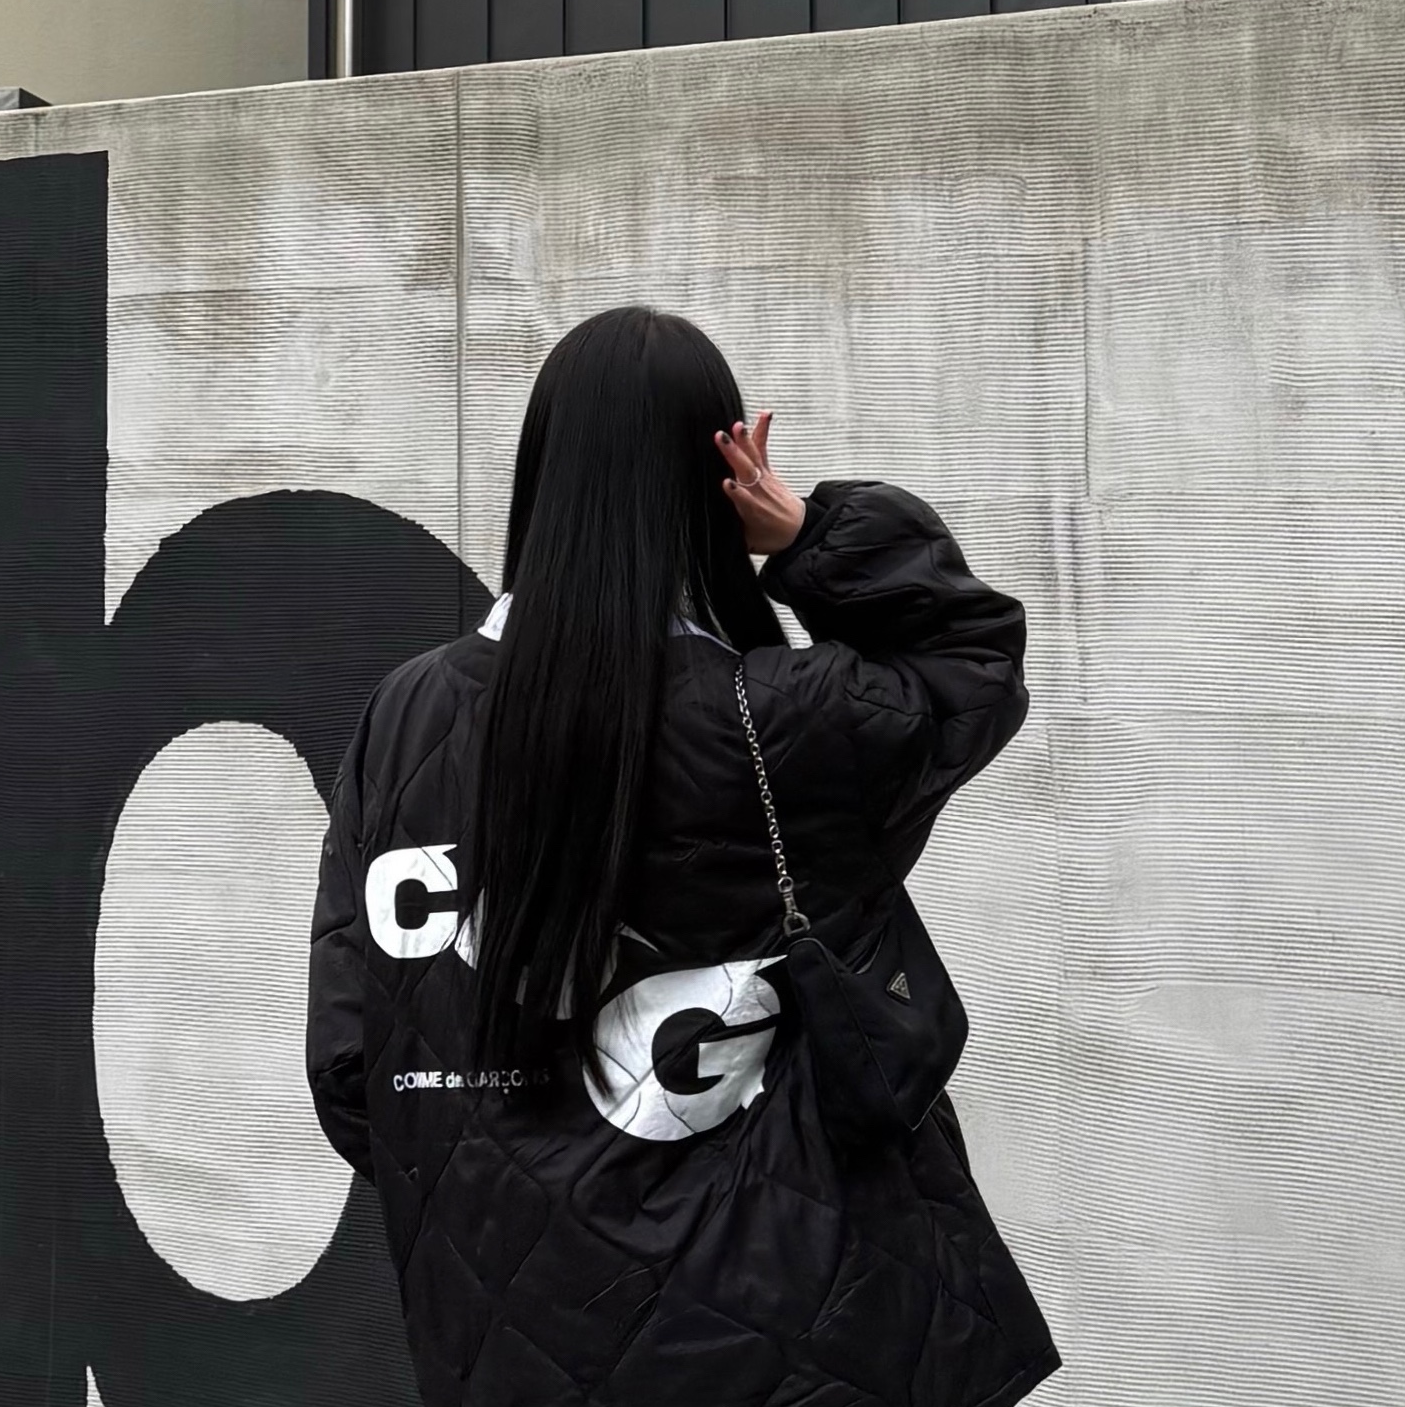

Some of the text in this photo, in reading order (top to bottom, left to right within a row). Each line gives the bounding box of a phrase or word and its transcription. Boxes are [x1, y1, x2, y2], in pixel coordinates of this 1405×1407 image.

[364, 843, 789, 1142] CG
[445, 1071, 465, 1089] de
[467, 1068, 551, 1094] GARÇO
